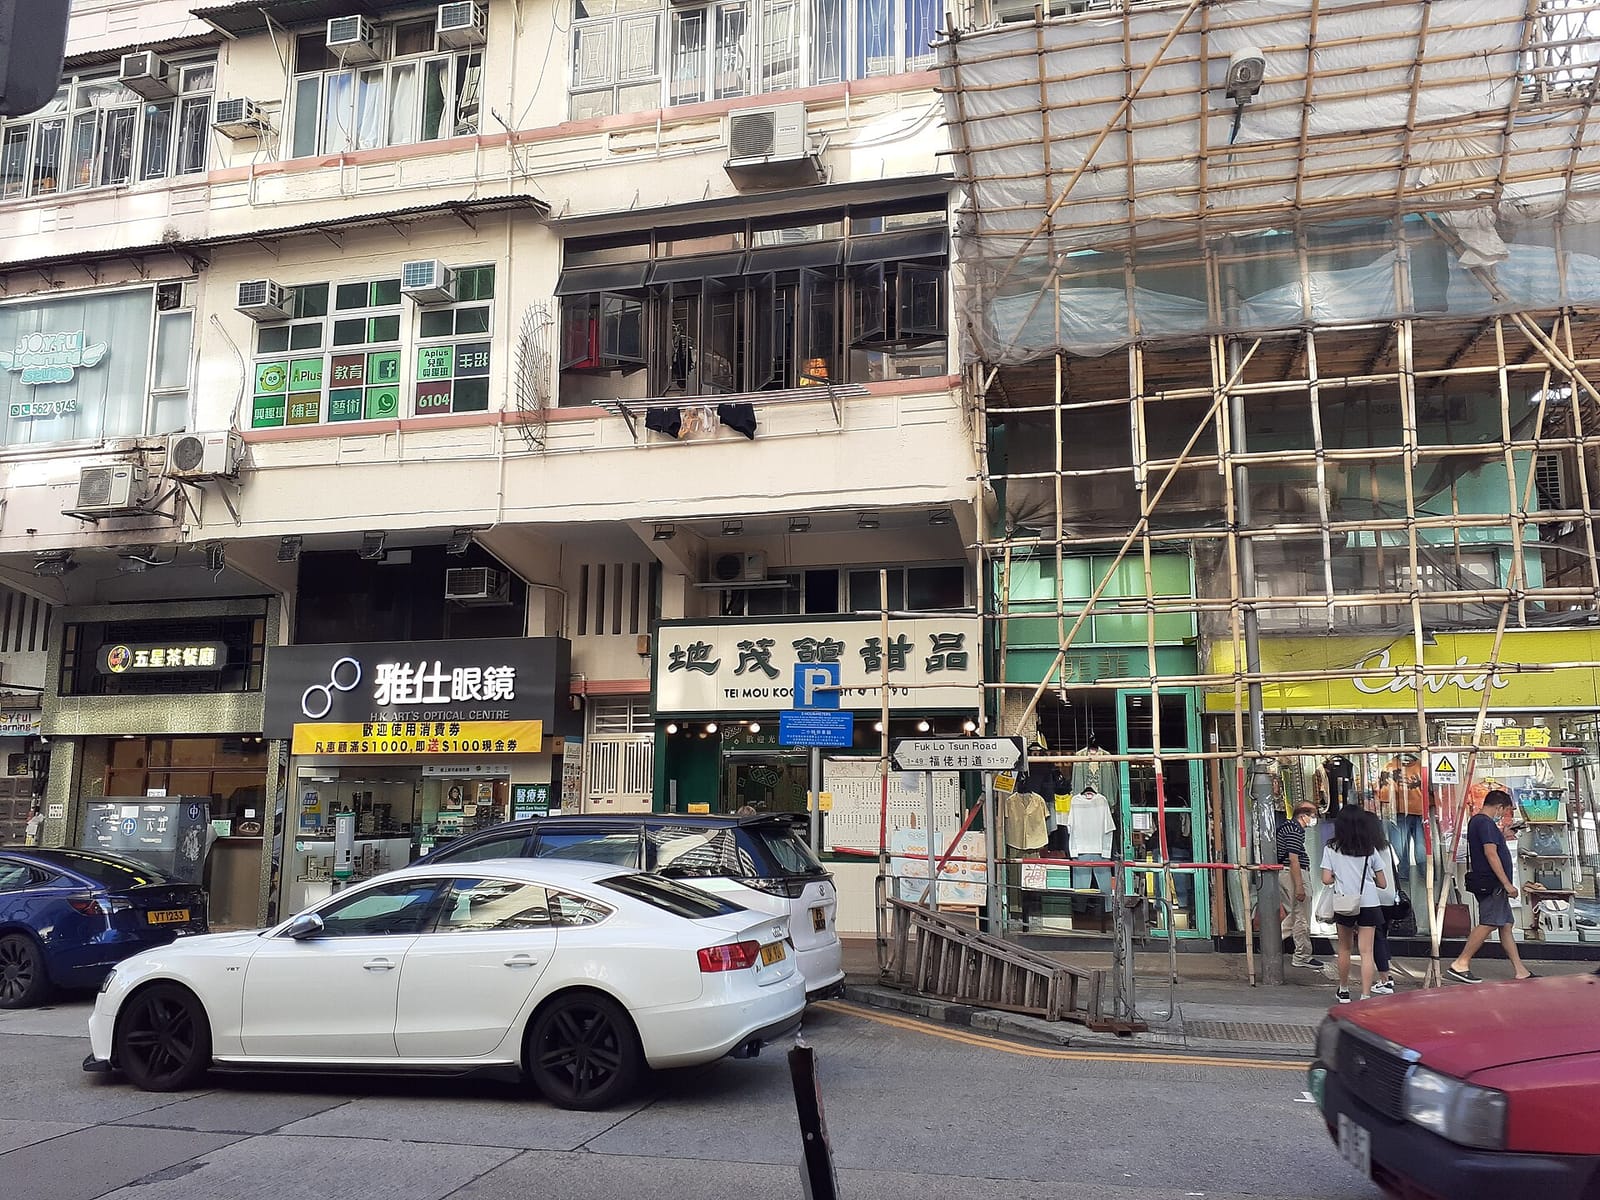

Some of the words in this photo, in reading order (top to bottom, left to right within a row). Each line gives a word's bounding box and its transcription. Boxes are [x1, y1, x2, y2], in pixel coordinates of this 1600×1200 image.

[293, 368, 323, 382] APlus
[335, 364, 363, 380] 教育
[32, 402, 54, 414] 5627
[55, 399, 76, 413] 8743
[332, 399, 360, 415] 藝術
[419, 393, 450, 408] 6104
[291, 402, 319, 418] 補習
[133, 647, 217, 668] 五星茶餐廳
[668, 632, 970, 679] 地茂館甜品
[373, 660, 517, 706] 雅仕眼鏡
[804, 668, 832, 705] P
[724, 688, 739, 698] TEI
[742, 688, 769, 698] MOU
[391, 710, 420, 722] ART'S
[423, 710, 466, 721] OPTICAL
[469, 709, 510, 720] CENTRE
[362, 721, 461, 737] 歡迎使用消費券
[314, 737, 518, 754] 凡惠顧滿$1000,即送$100現金券
[914, 742, 931, 751] Fuk
[933, 742, 945, 751] Lo
[949, 742, 970, 751] Tsun
[972, 741, 997, 750] Road
[929, 755, 983, 767] 福佬村道
[516, 788, 547, 803] 醫療券
[154, 910, 184, 921] VT1233
